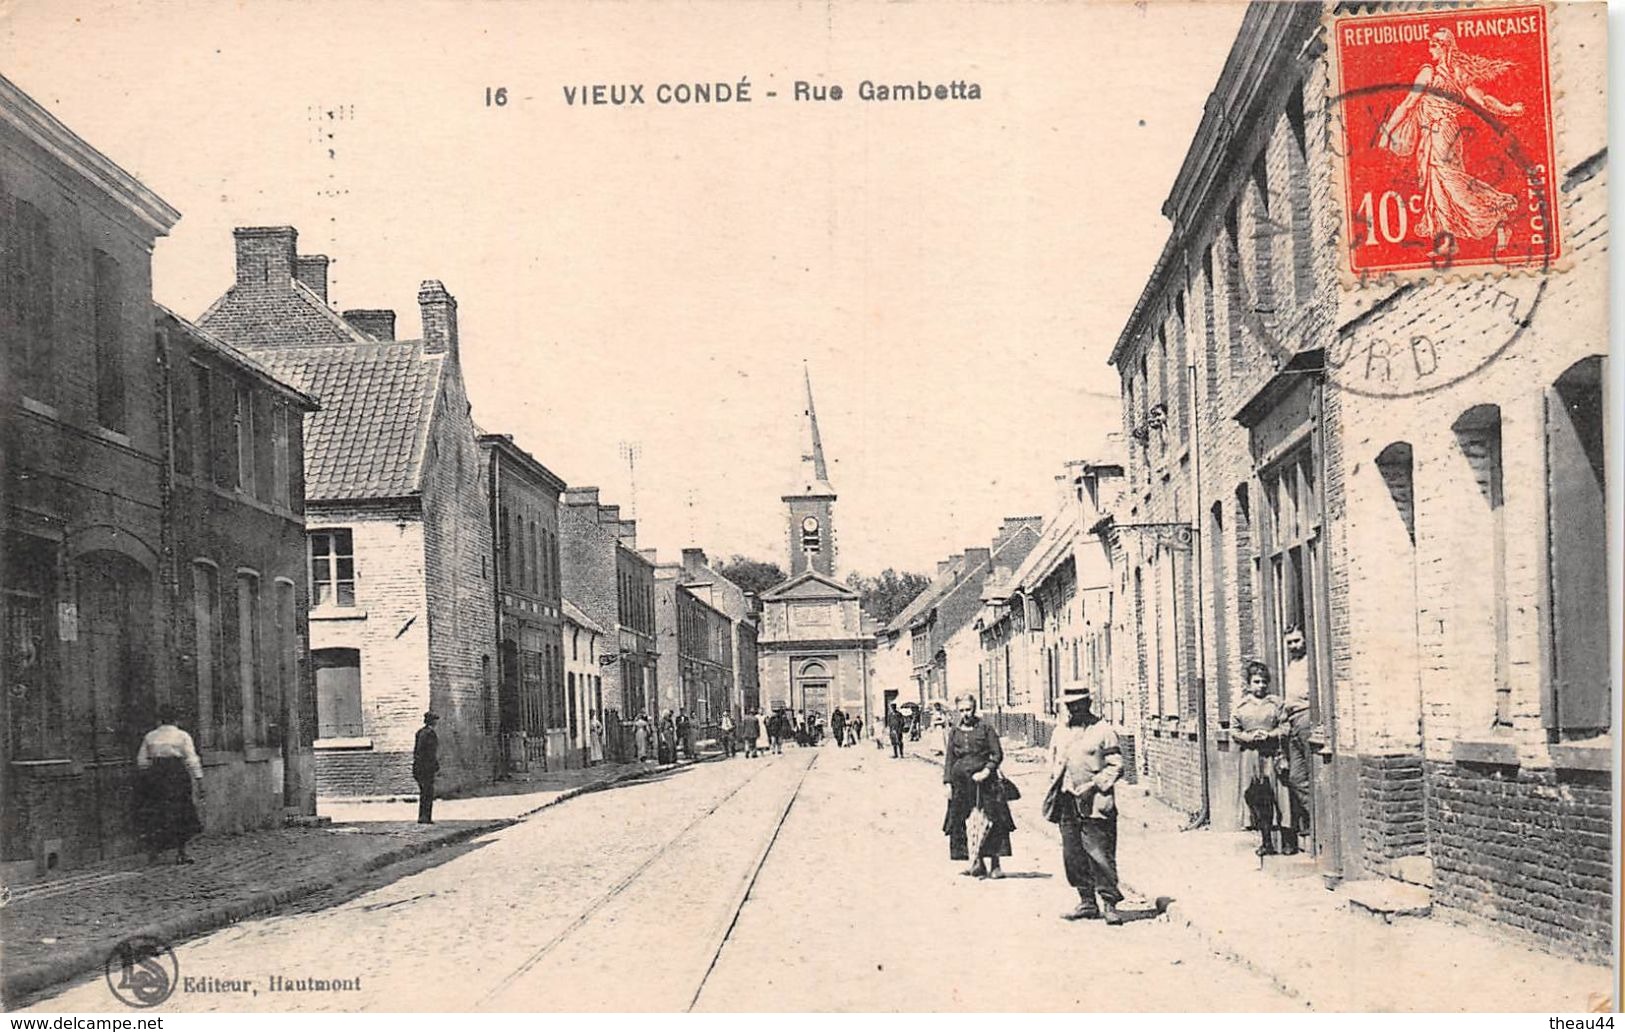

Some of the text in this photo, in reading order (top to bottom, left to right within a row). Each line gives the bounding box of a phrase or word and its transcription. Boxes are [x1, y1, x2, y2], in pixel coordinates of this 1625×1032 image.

[1345, 15, 1537, 46] REPUBLIQUE FRANÇAISE
[1528, 164, 1546, 245] POSTES
